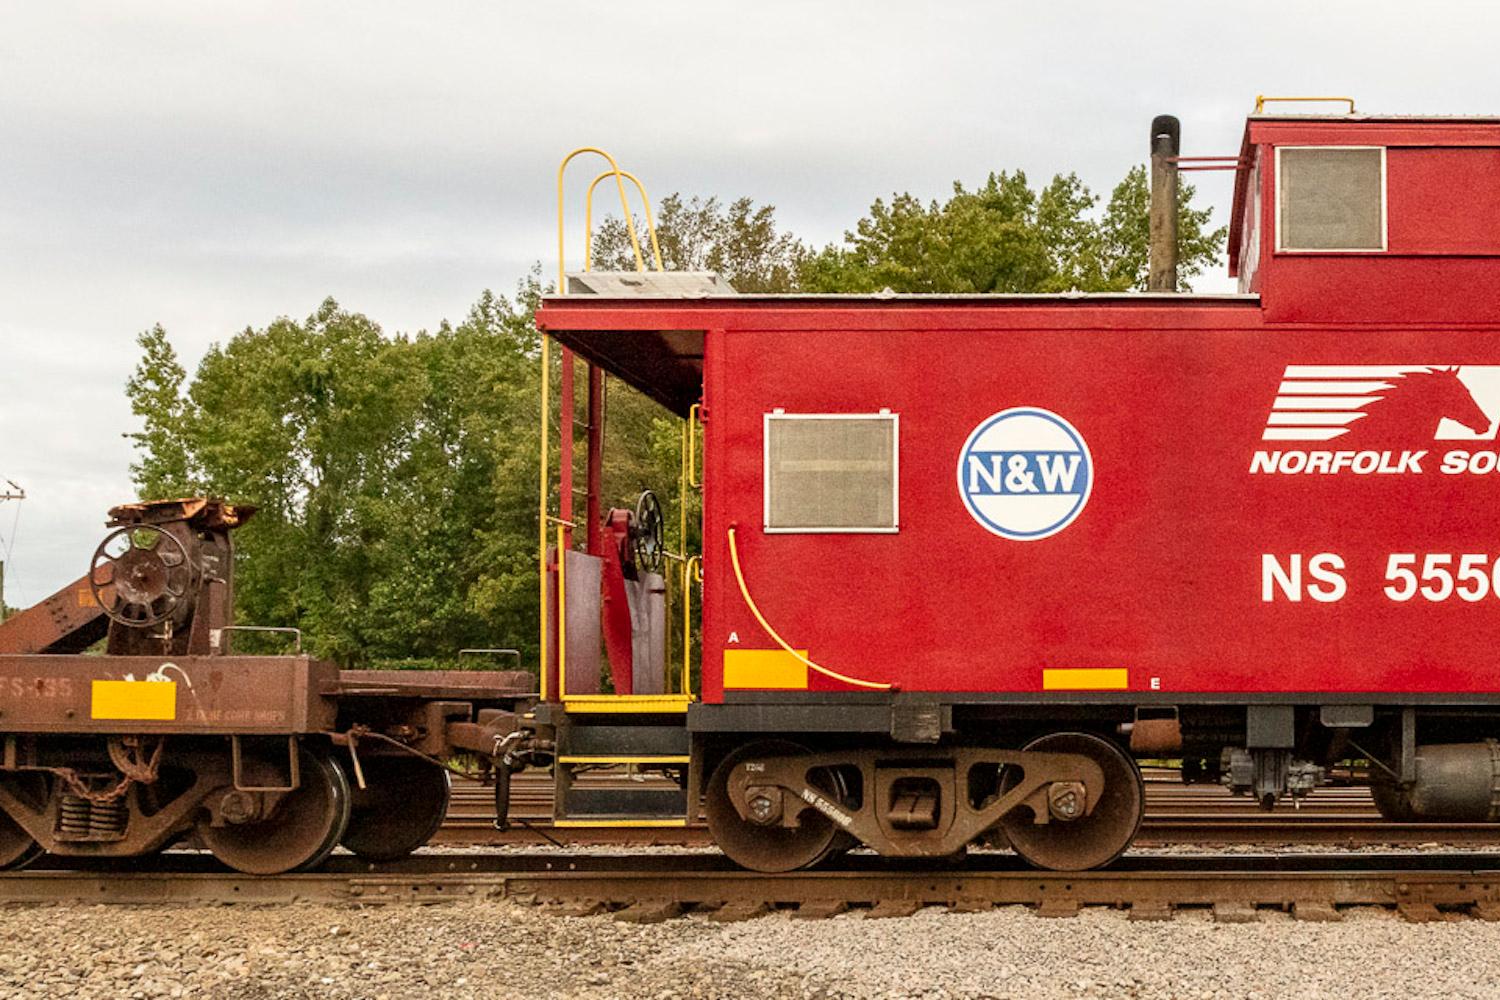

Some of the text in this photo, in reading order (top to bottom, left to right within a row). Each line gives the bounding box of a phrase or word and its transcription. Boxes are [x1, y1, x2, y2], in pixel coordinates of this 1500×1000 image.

[967, 454, 1082, 493] N&W
[1249, 450, 1429, 475] NORFOLK
[1261, 553, 1347, 602] NS
[728, 631, 740, 643] A
[1150, 677, 1161, 690] E
